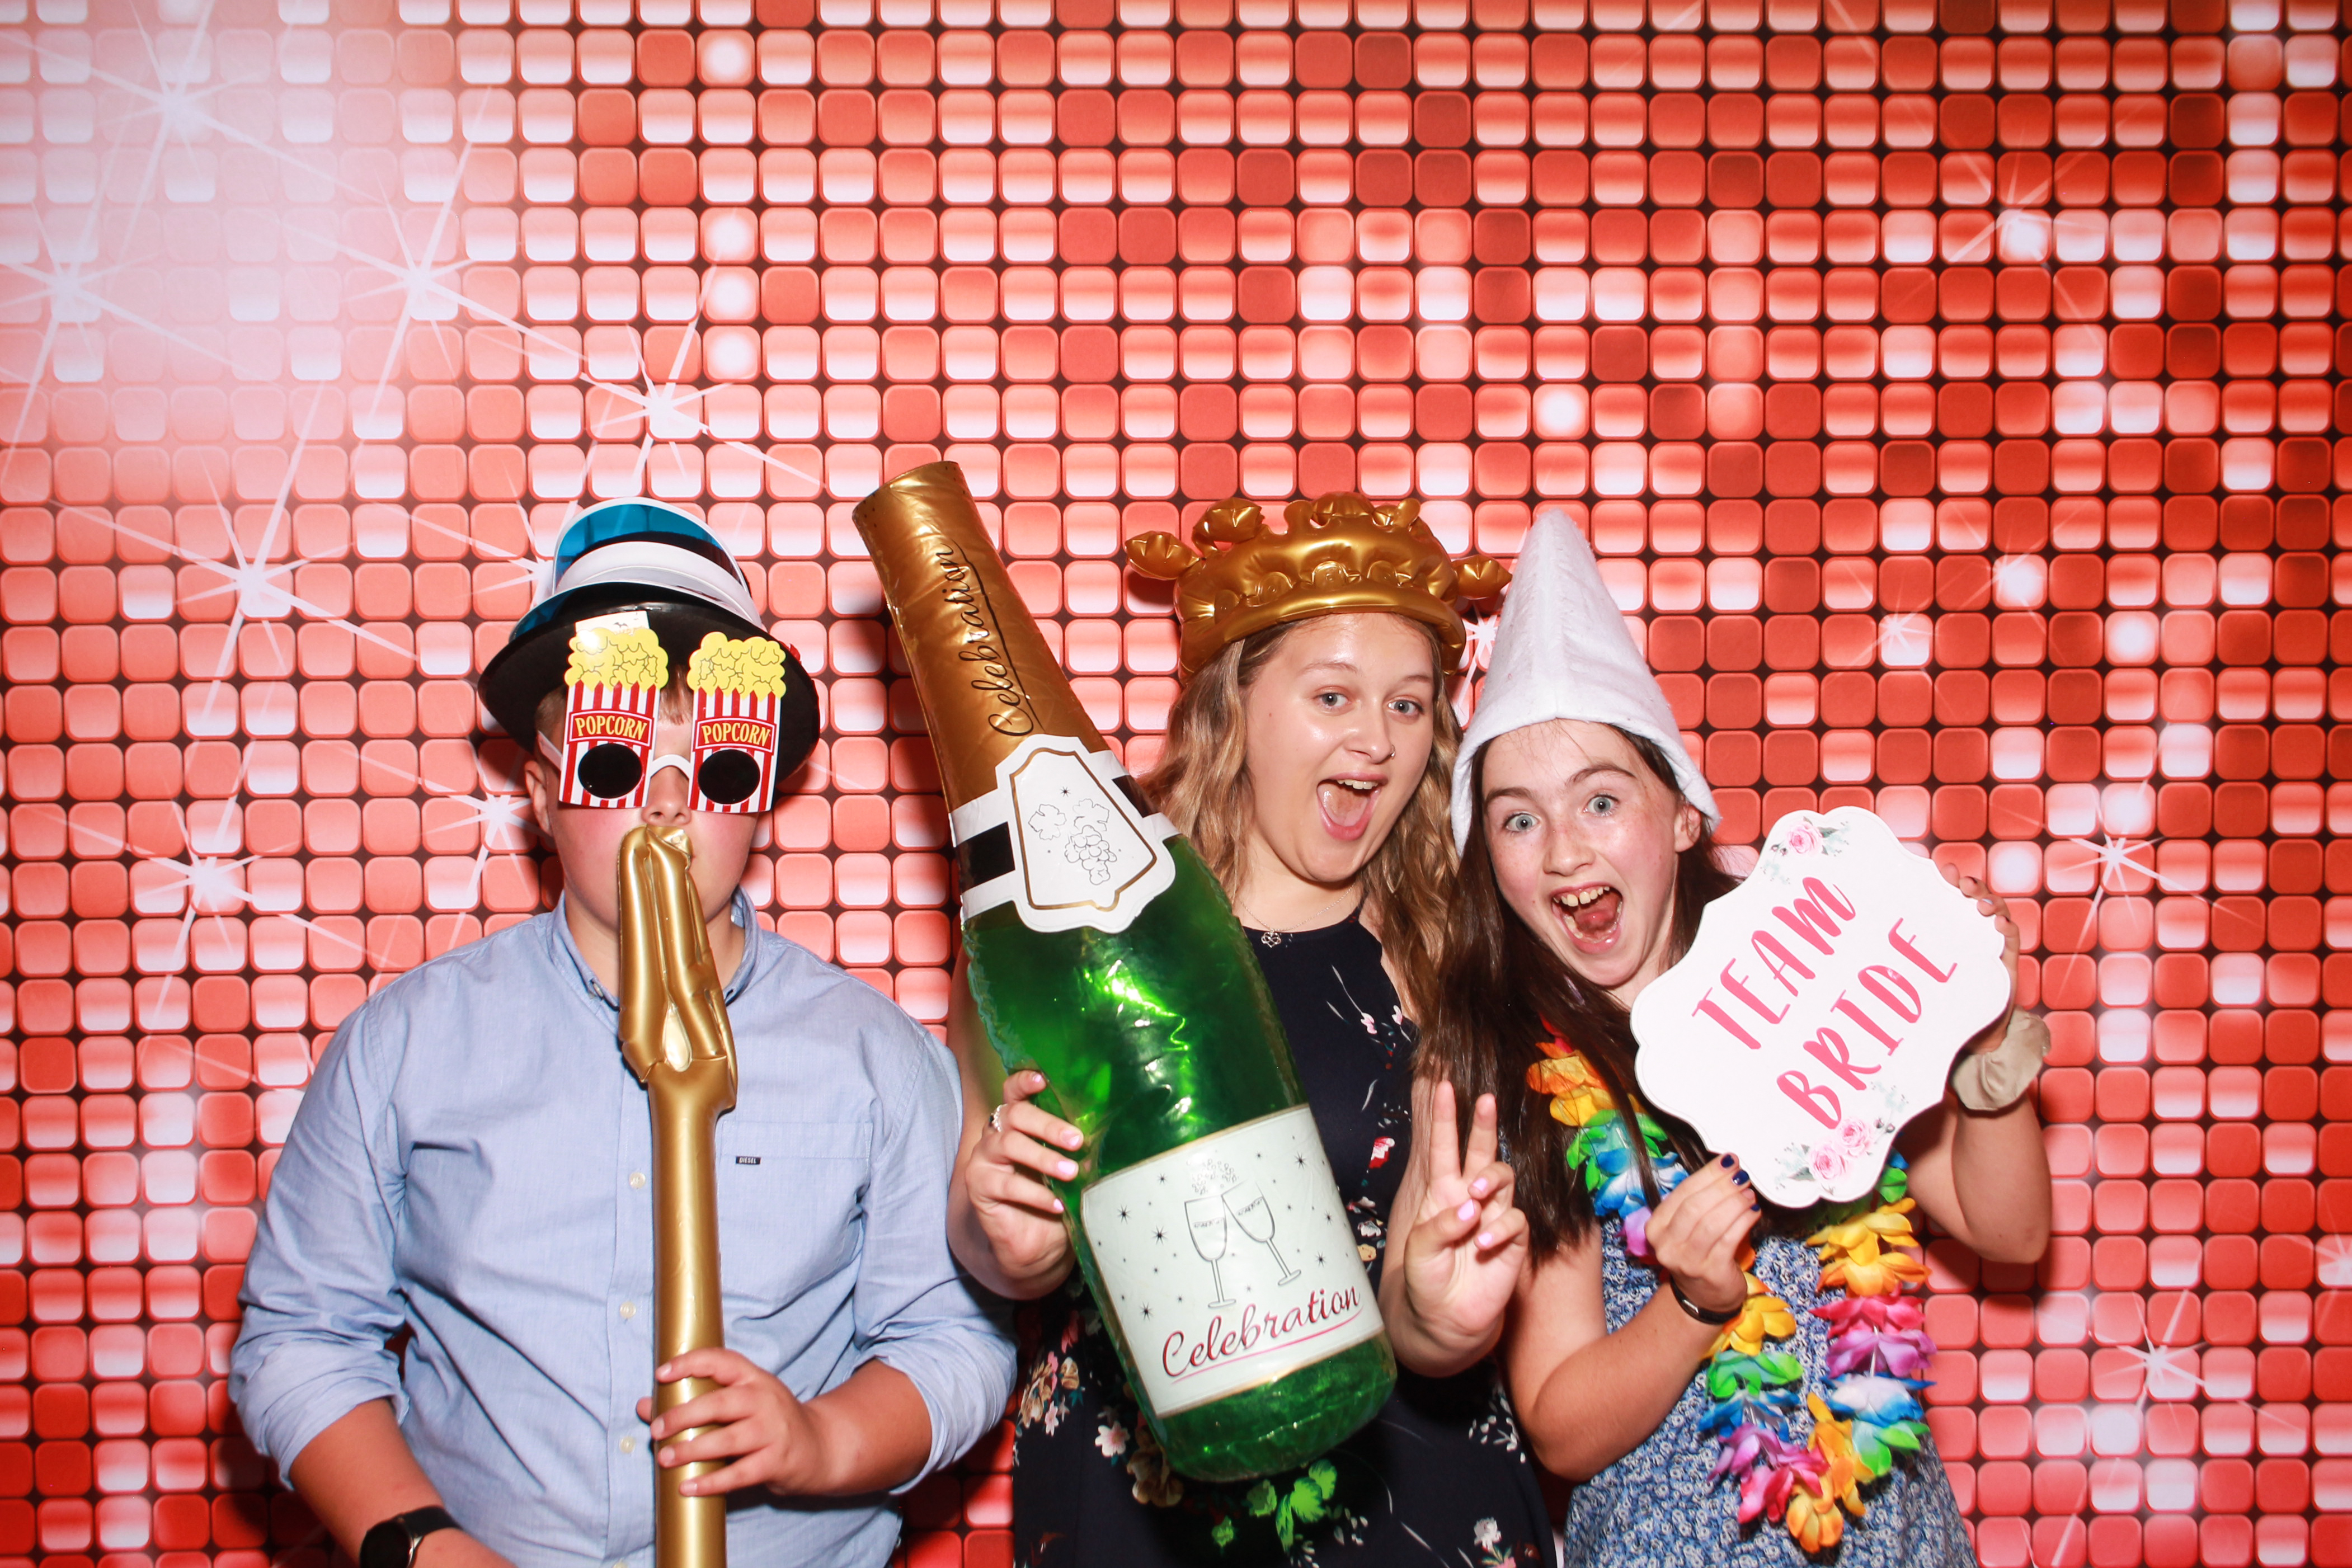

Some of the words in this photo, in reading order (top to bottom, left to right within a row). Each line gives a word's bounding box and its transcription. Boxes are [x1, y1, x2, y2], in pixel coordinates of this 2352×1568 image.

[936, 543, 1034, 737] Celebration
[575, 715, 647, 741] POPCORN
[702, 722, 770, 747] POPCORN
[1692, 877, 1856, 1049] TEAM
[1776, 917, 1957, 1129] BRIDE
[1162, 1286, 1360, 1377] Celebration
